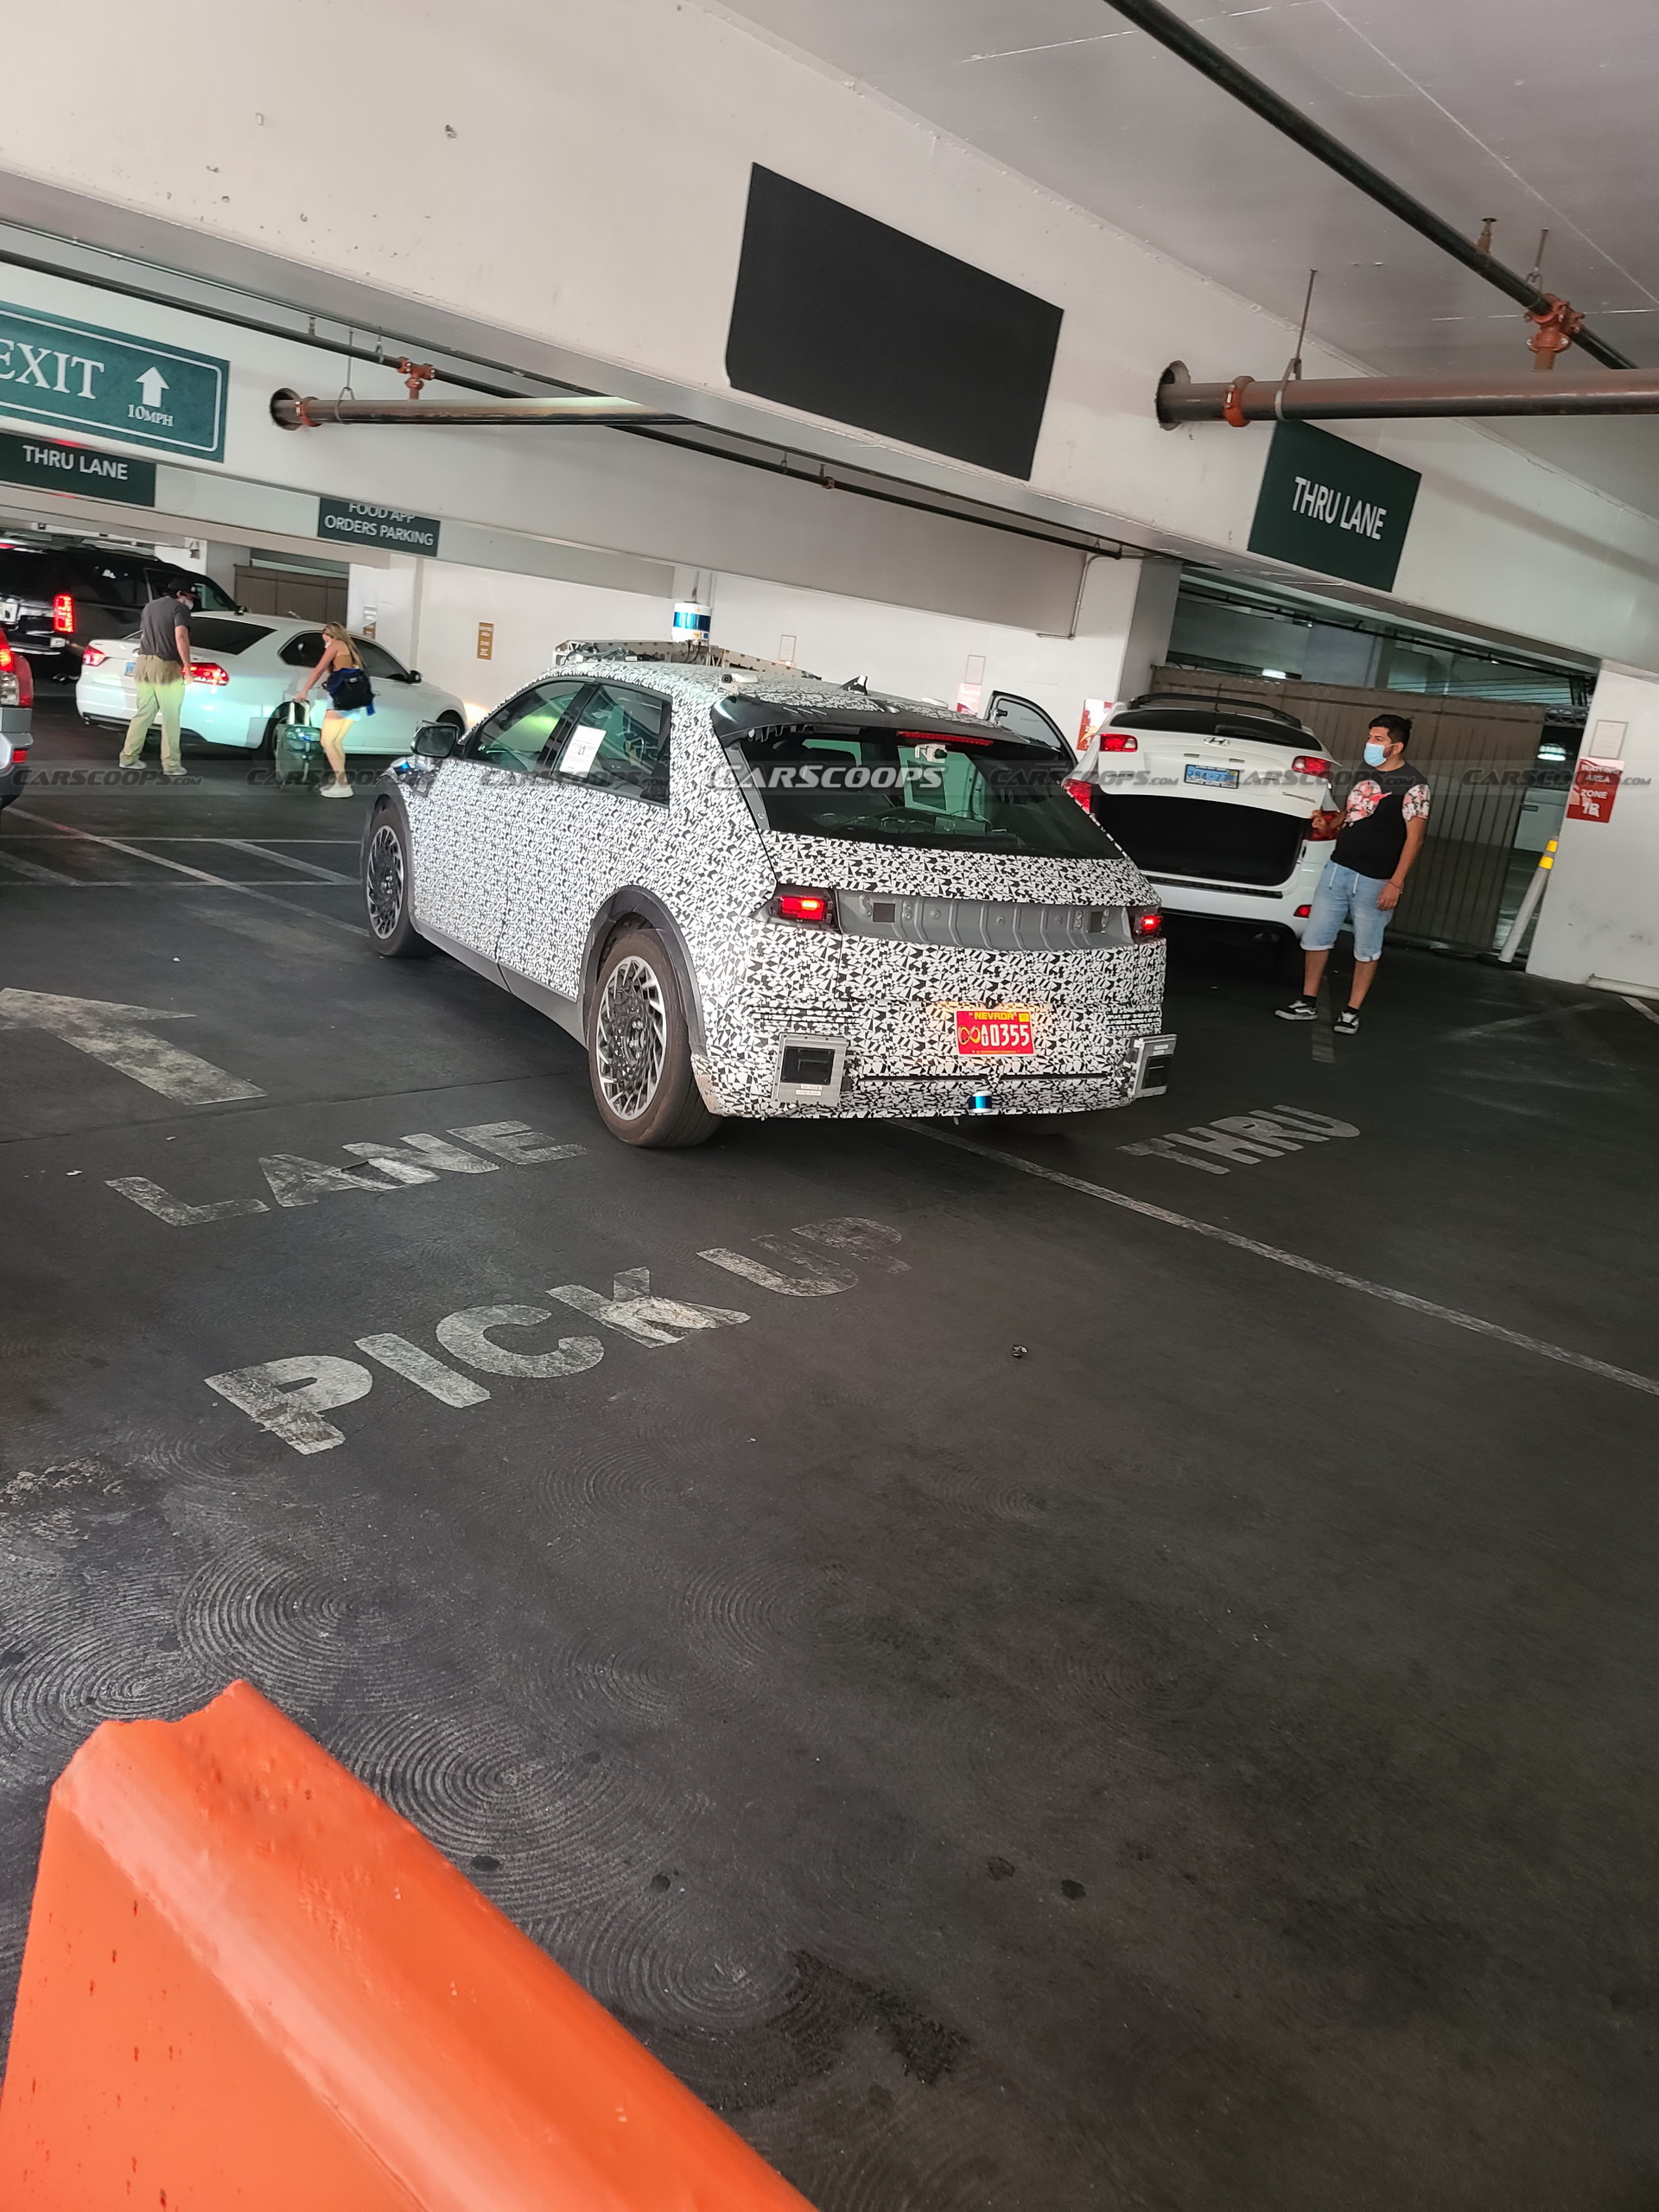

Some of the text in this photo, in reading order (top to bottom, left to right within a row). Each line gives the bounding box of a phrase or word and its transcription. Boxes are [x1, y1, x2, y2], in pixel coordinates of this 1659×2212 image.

[22, 445, 128, 480] THRU LANE
[348, 503, 388, 518] FOOD
[1293, 476, 1387, 540] THRU LANE
[324, 515, 434, 546] ORDERS PARKING
[1580, 789, 1608, 799] ZONE
[1585, 773, 1611, 784] AREA
[974, 1012, 1015, 1020] NEVADA
[1116, 1104, 1361, 1175] THRU
[104, 1121, 588, 1226] LANE
[203, 1217, 912, 1455] PICK UP
